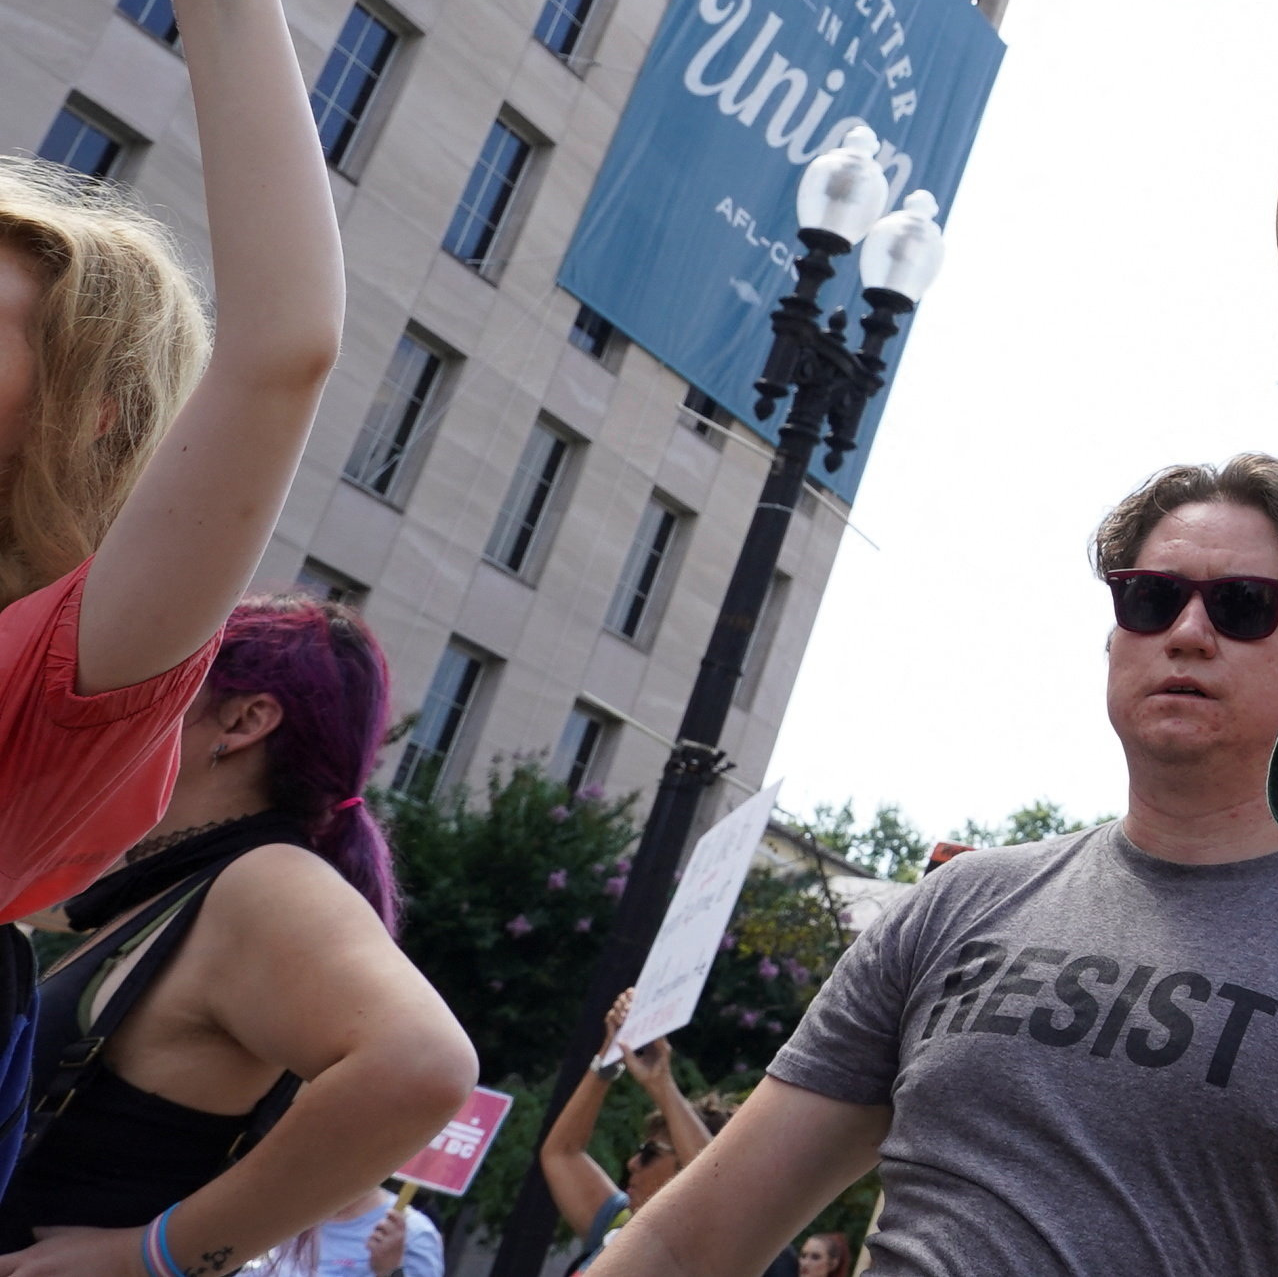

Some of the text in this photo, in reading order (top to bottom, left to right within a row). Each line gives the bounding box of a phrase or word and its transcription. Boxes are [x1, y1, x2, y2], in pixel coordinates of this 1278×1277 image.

[816, 5, 861, 68] IN A
[715, 196, 800, 282] AFL-CI
